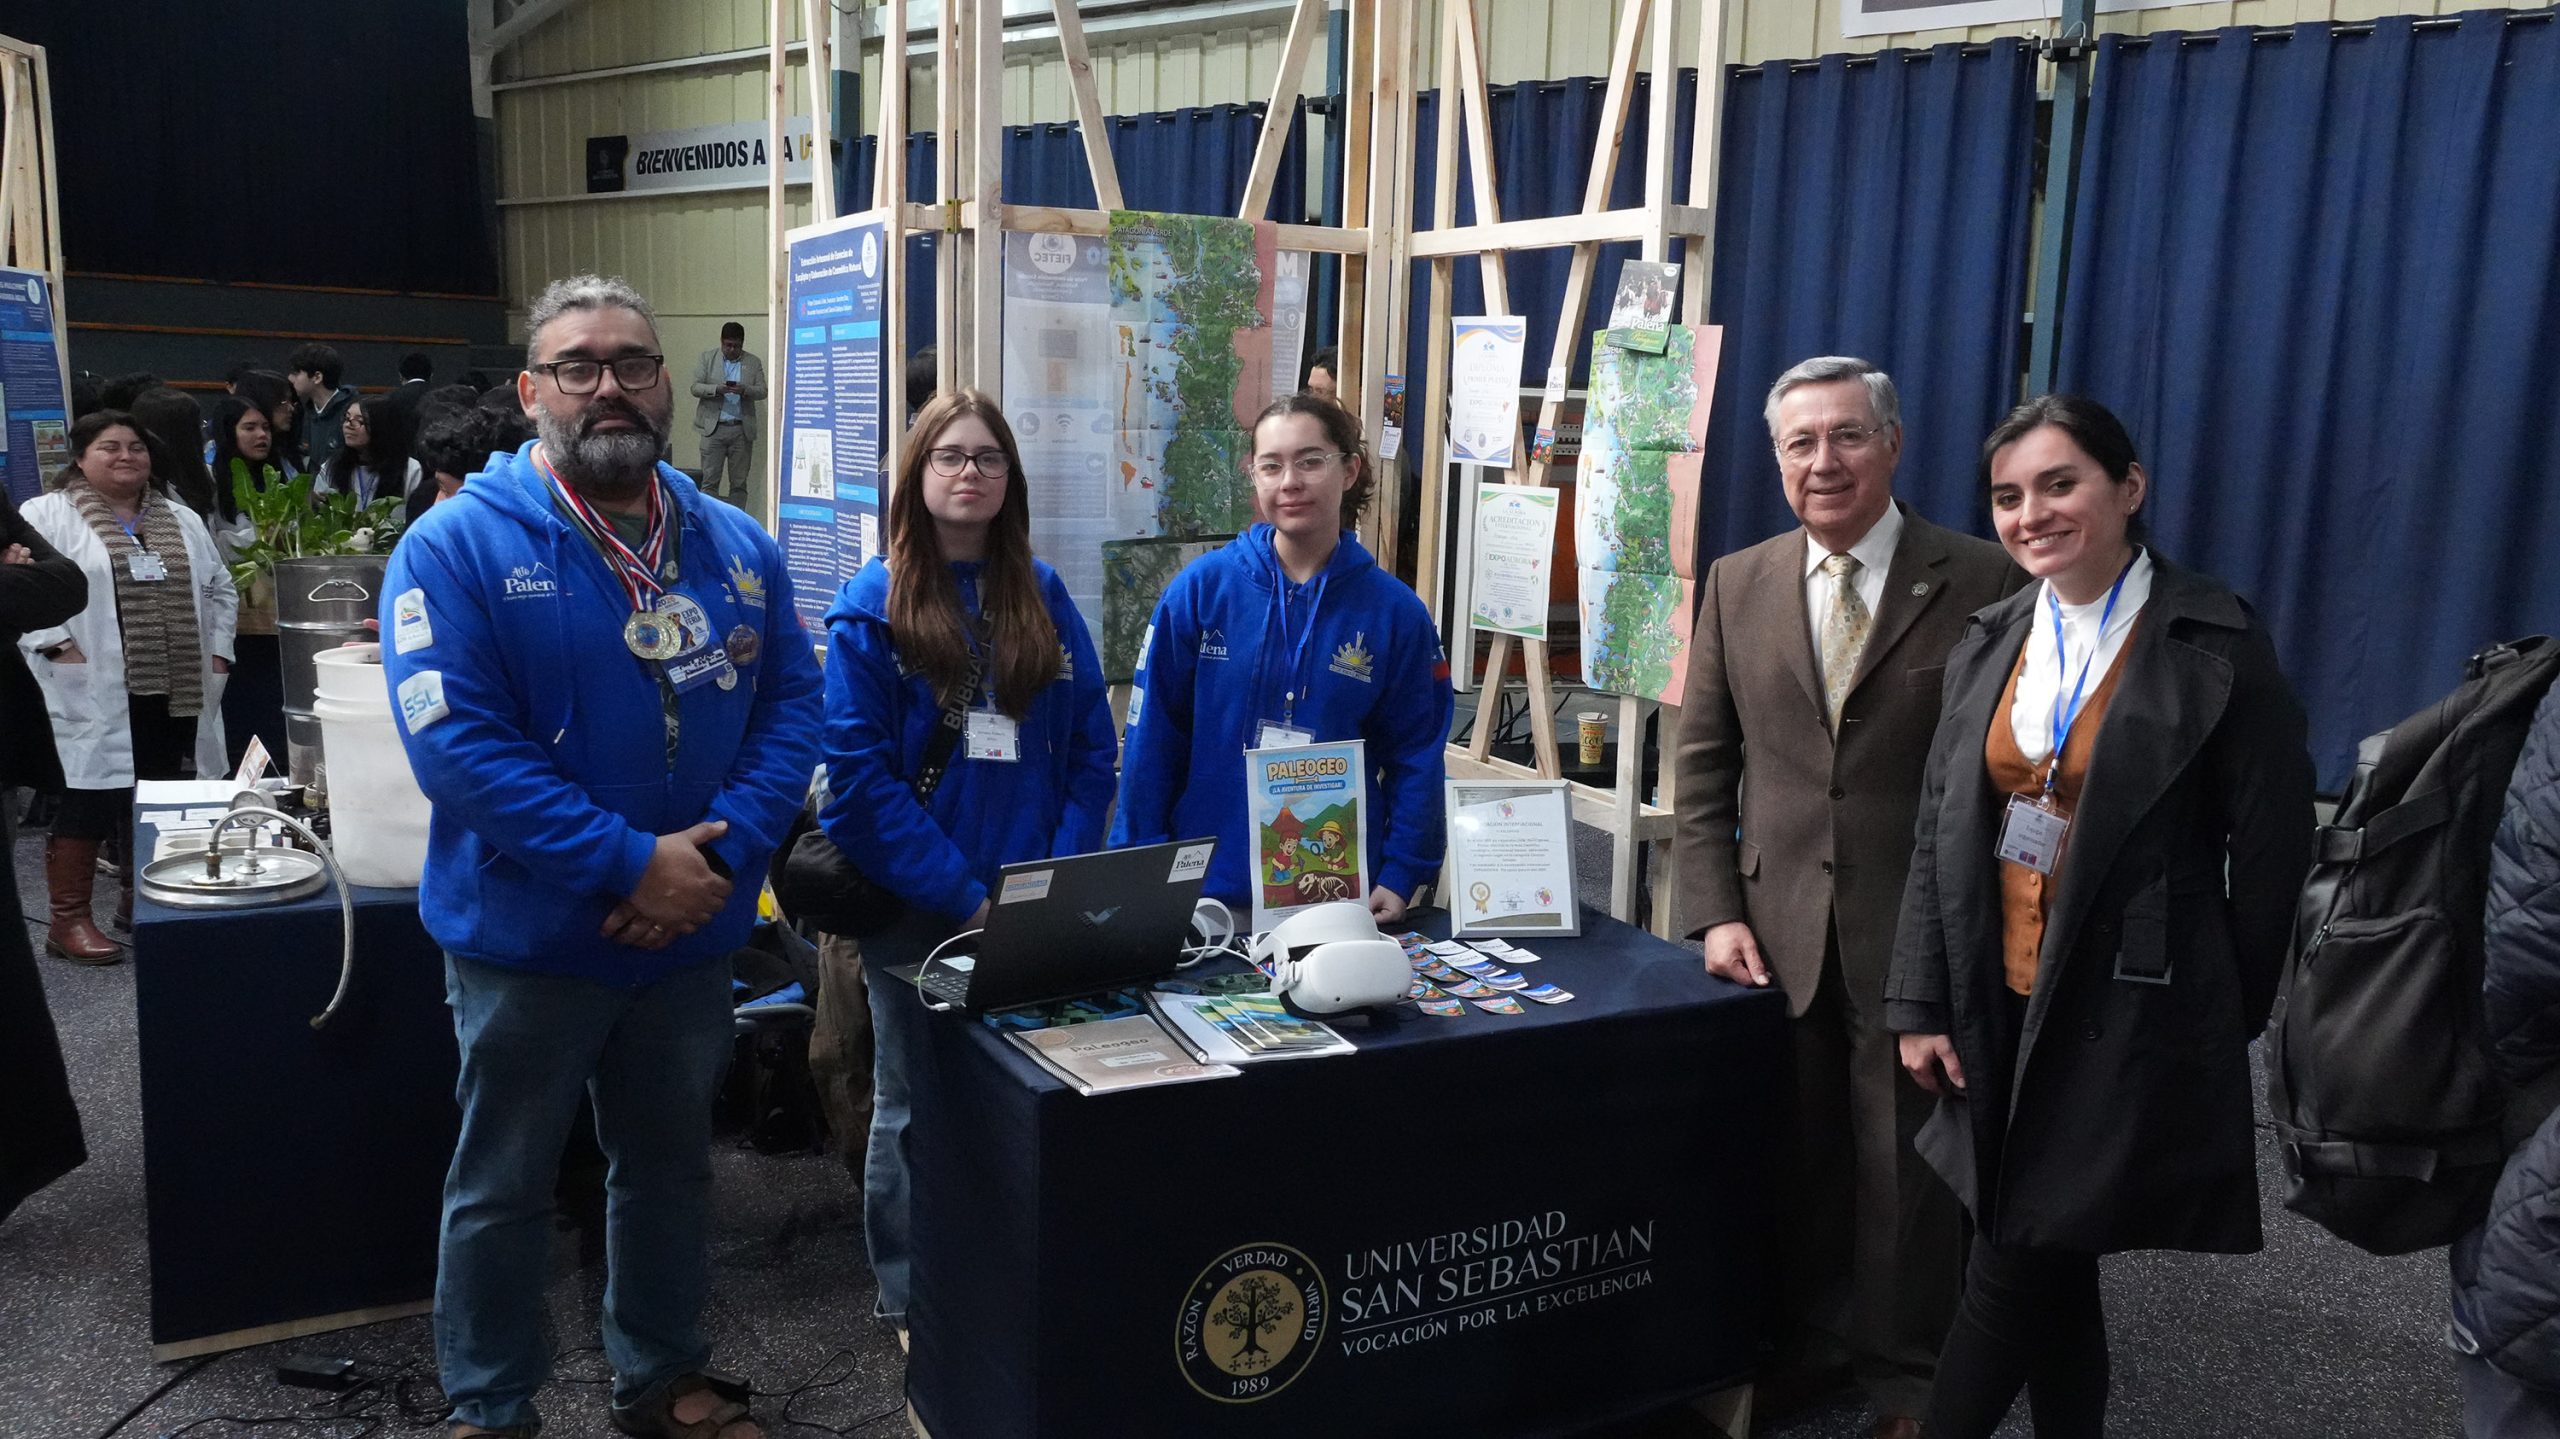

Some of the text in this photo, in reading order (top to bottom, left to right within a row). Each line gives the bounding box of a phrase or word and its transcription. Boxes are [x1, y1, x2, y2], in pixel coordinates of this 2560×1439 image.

[636, 141, 748, 175] BIENVENIDOS
[752, 139, 767, 166] A
[681, 606, 699, 619] EXPO
[404, 690, 440, 719] SSL
[1266, 756, 1348, 781] PALEOGEO
[1346, 1210, 1566, 1280] UNIVERSIDAD
[1222, 1251, 1288, 1273] VERDAD
[1341, 1219, 1656, 1323] SAN SEBASTIAN
[1303, 1280, 1321, 1341] VIRTUD
[1341, 1269, 1653, 1357] VOCACIÓN POR LA EXCELENCIA
[1231, 1376, 1269, 1396] 1989
